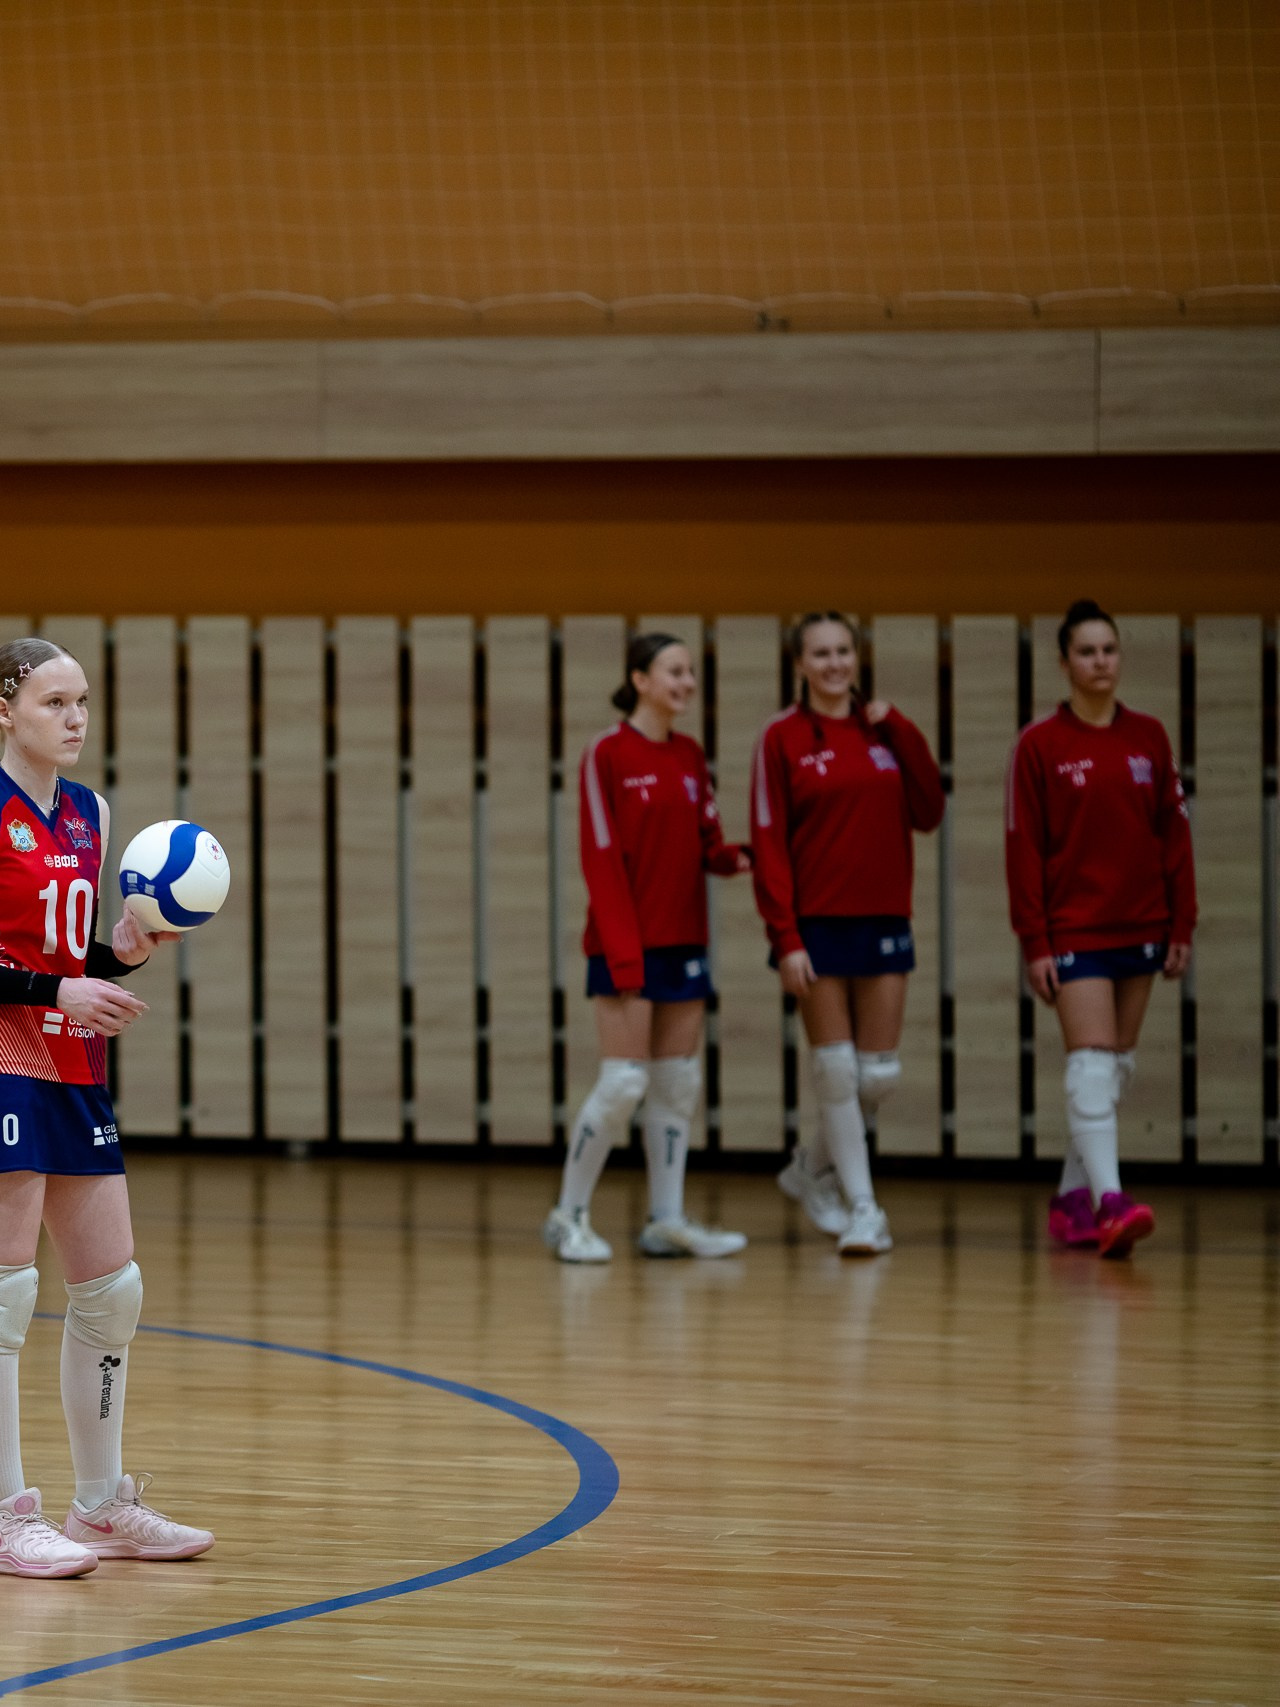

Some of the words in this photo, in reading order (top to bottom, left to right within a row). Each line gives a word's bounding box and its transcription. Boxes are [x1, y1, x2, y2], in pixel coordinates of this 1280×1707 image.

[53, 854, 79, 868] ВФВ
[38, 878, 94, 961] 10
[67, 1026, 96, 1039] VISION
